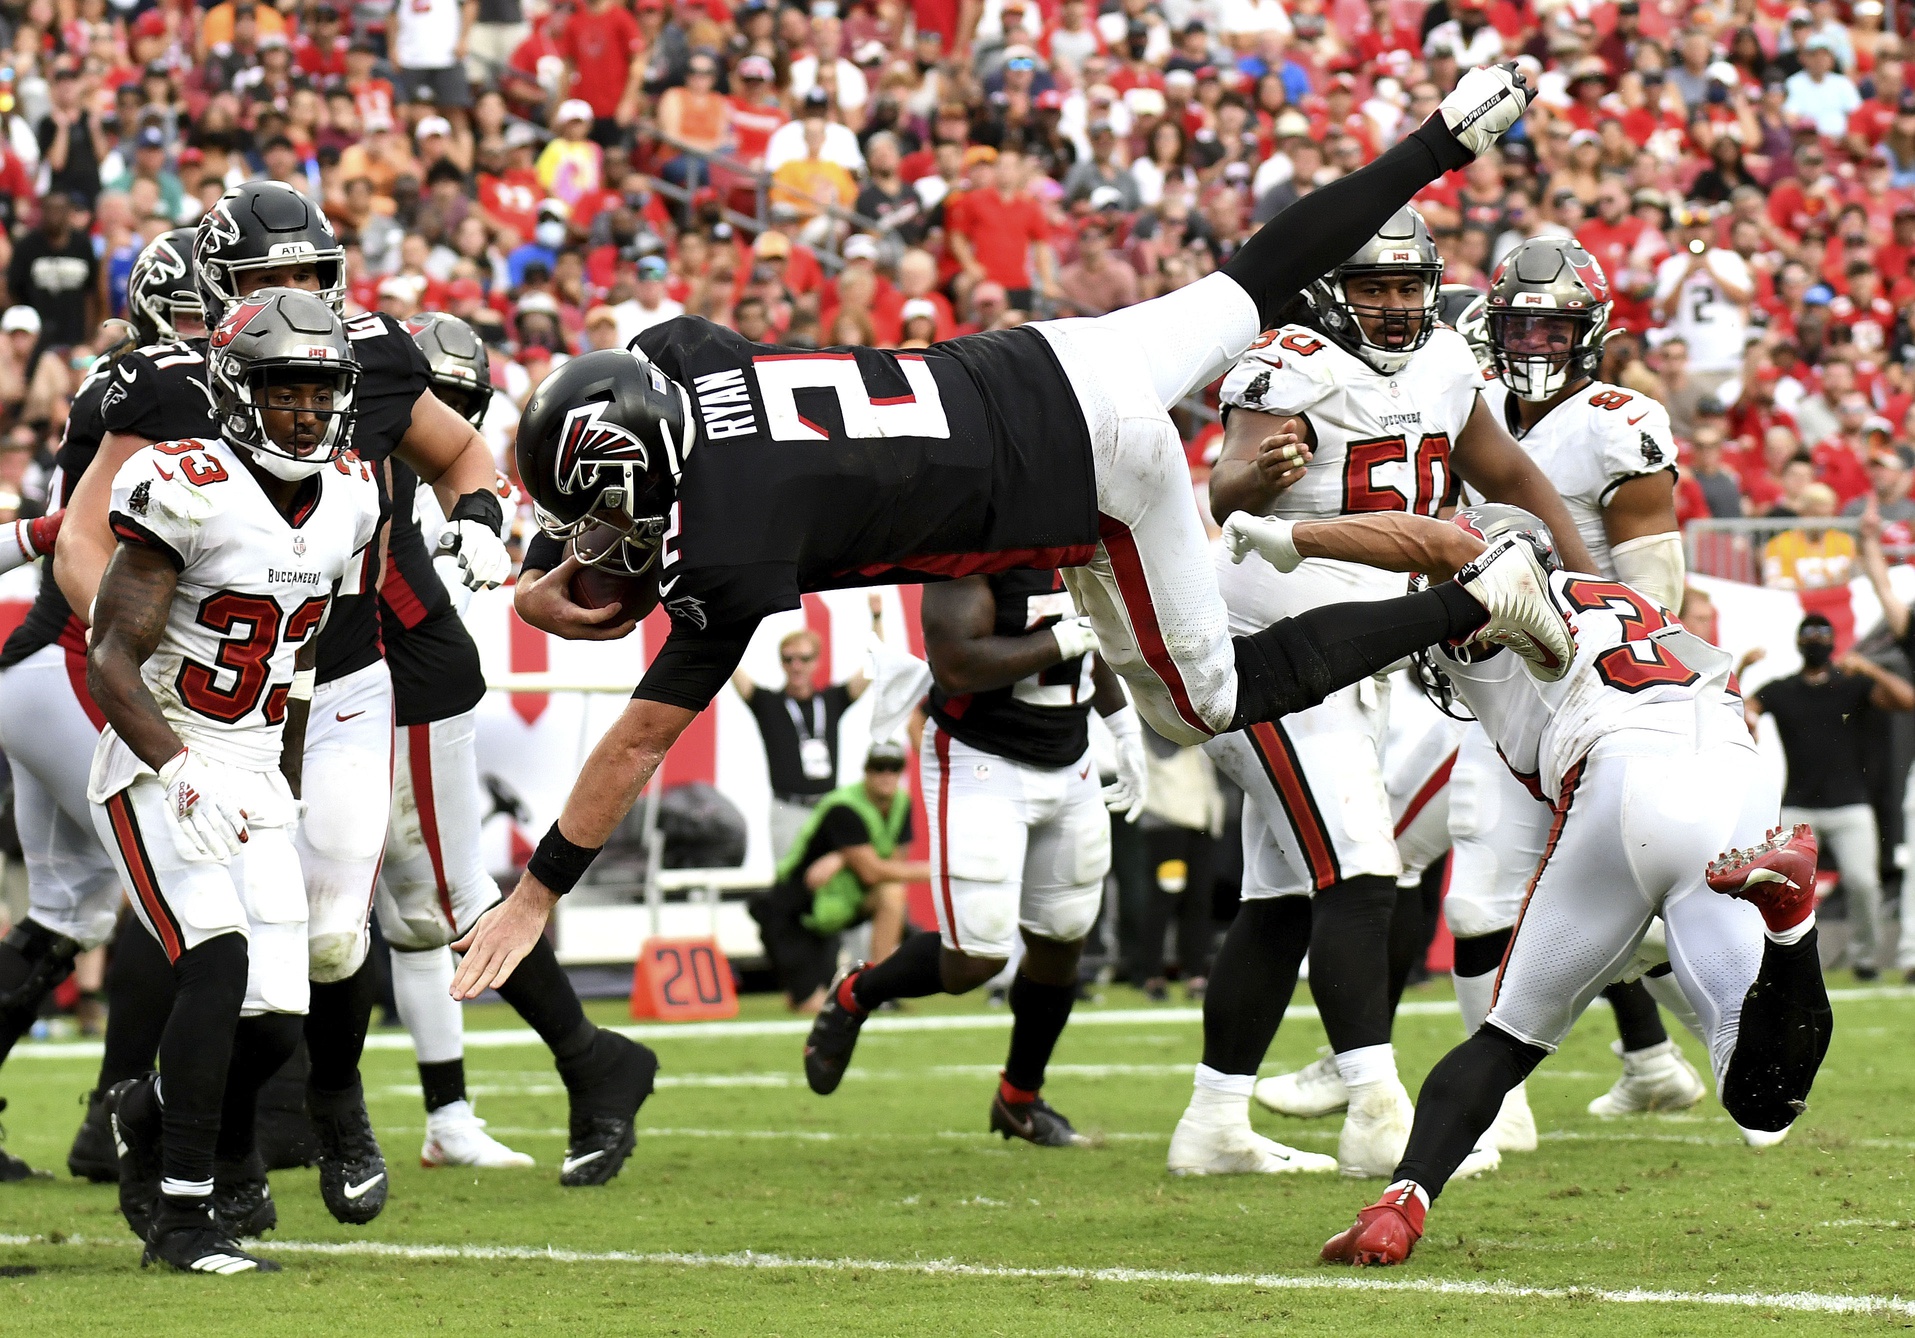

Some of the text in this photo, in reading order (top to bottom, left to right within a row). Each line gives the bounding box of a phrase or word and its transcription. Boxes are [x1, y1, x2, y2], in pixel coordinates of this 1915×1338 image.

[282, 245, 305, 255] ATL
[1690, 286, 1715, 324] 2
[693, 368, 757, 441] RYAN
[752, 353, 951, 442] 2
[153, 438, 229, 488] 33
[1340, 431, 1451, 517] 50
[1562, 578, 1743, 695] 3
[178, 781, 186, 817] adidas
[656, 947, 723, 1006] 20
